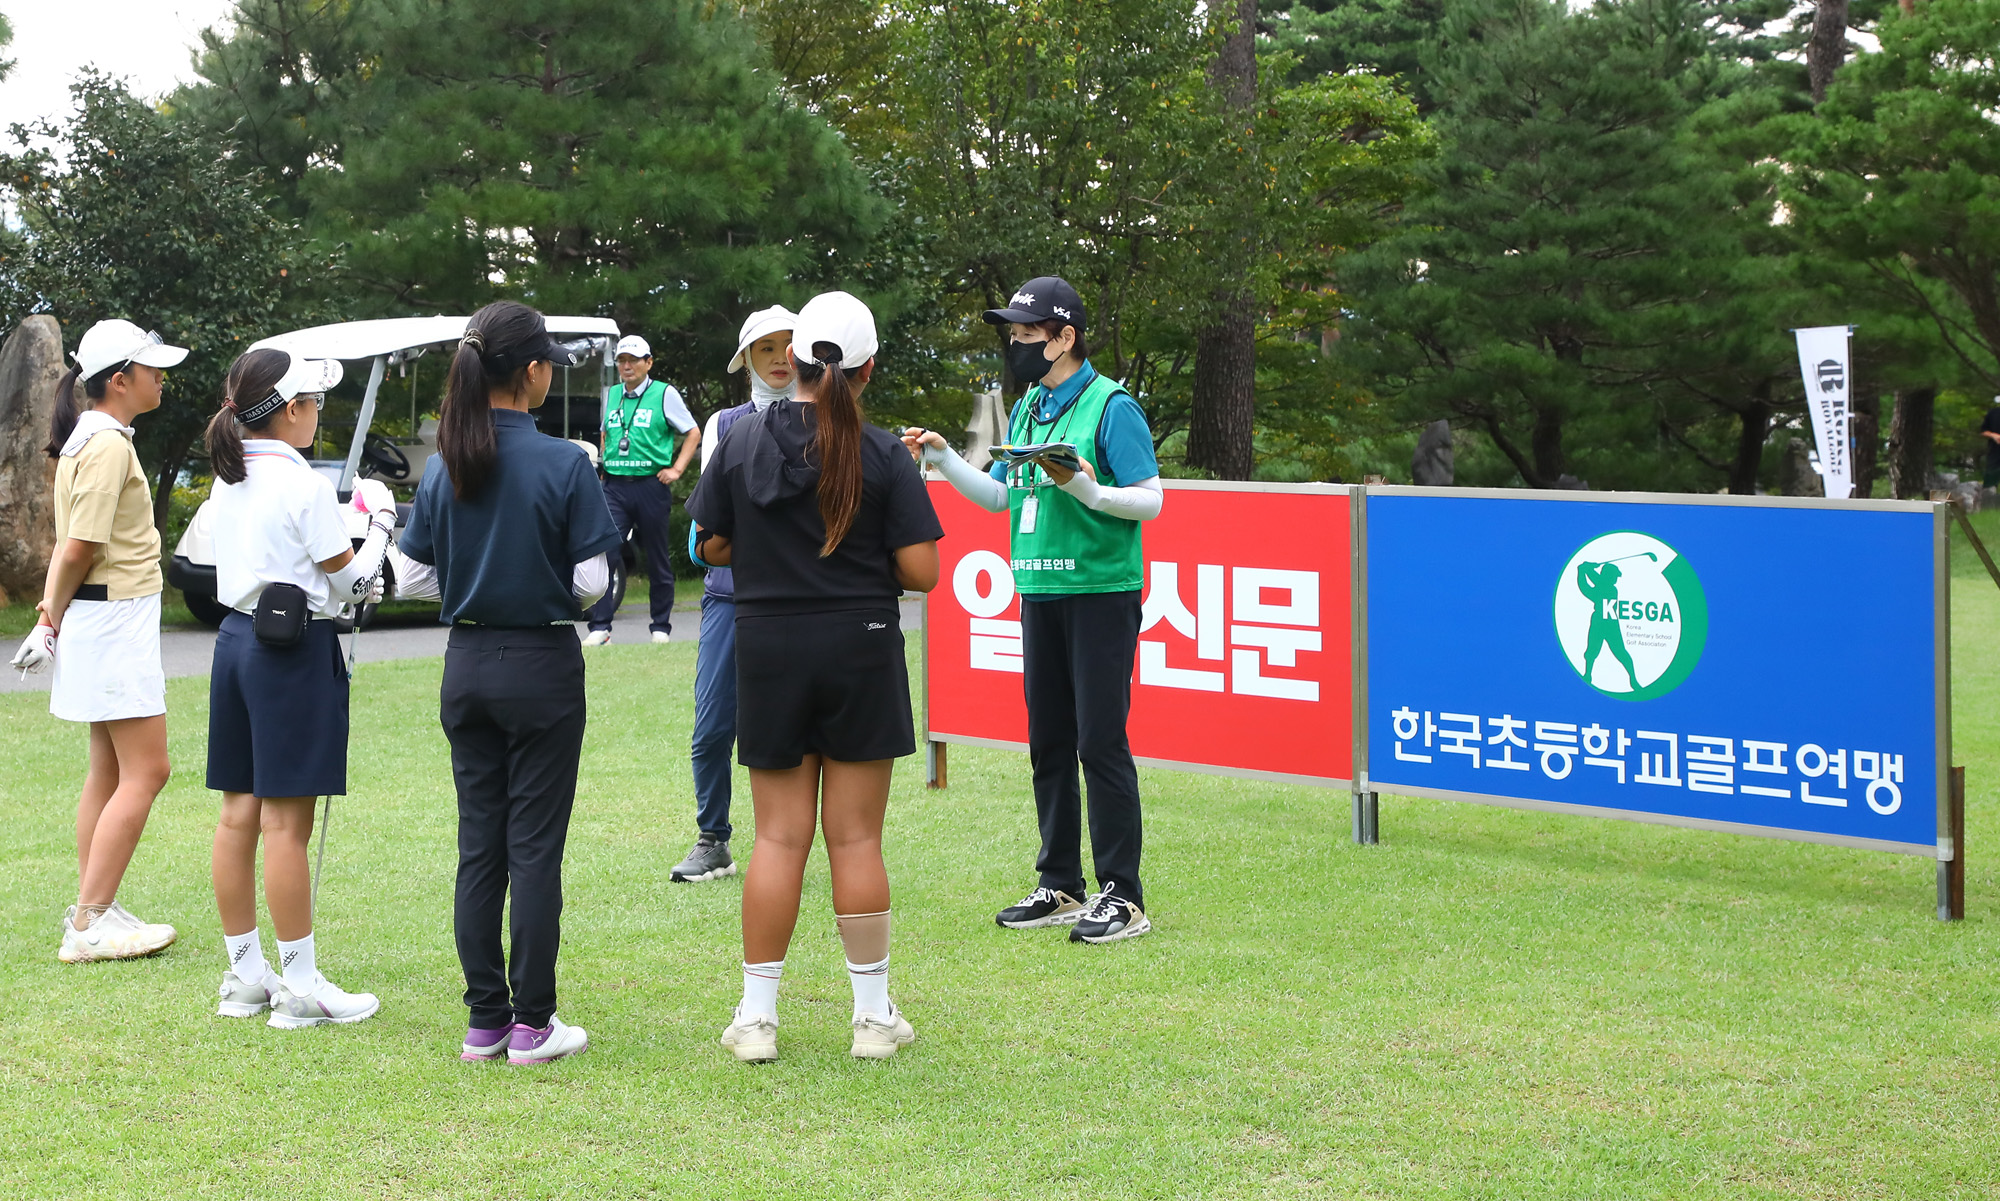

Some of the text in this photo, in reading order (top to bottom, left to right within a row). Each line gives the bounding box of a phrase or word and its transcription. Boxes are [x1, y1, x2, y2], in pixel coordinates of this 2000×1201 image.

[1053, 306, 1071, 320] VS4
[246, 401, 274, 419] MASTER
[608, 408, 653, 428] 안전
[1602, 598, 1674, 623] KESGA
[952, 549, 1323, 702] 일신문
[1626, 631, 1654, 639] Elementary
[1638, 640, 1667, 648] Association
[1391, 706, 1904, 816] 한국초등학교골프연맹
